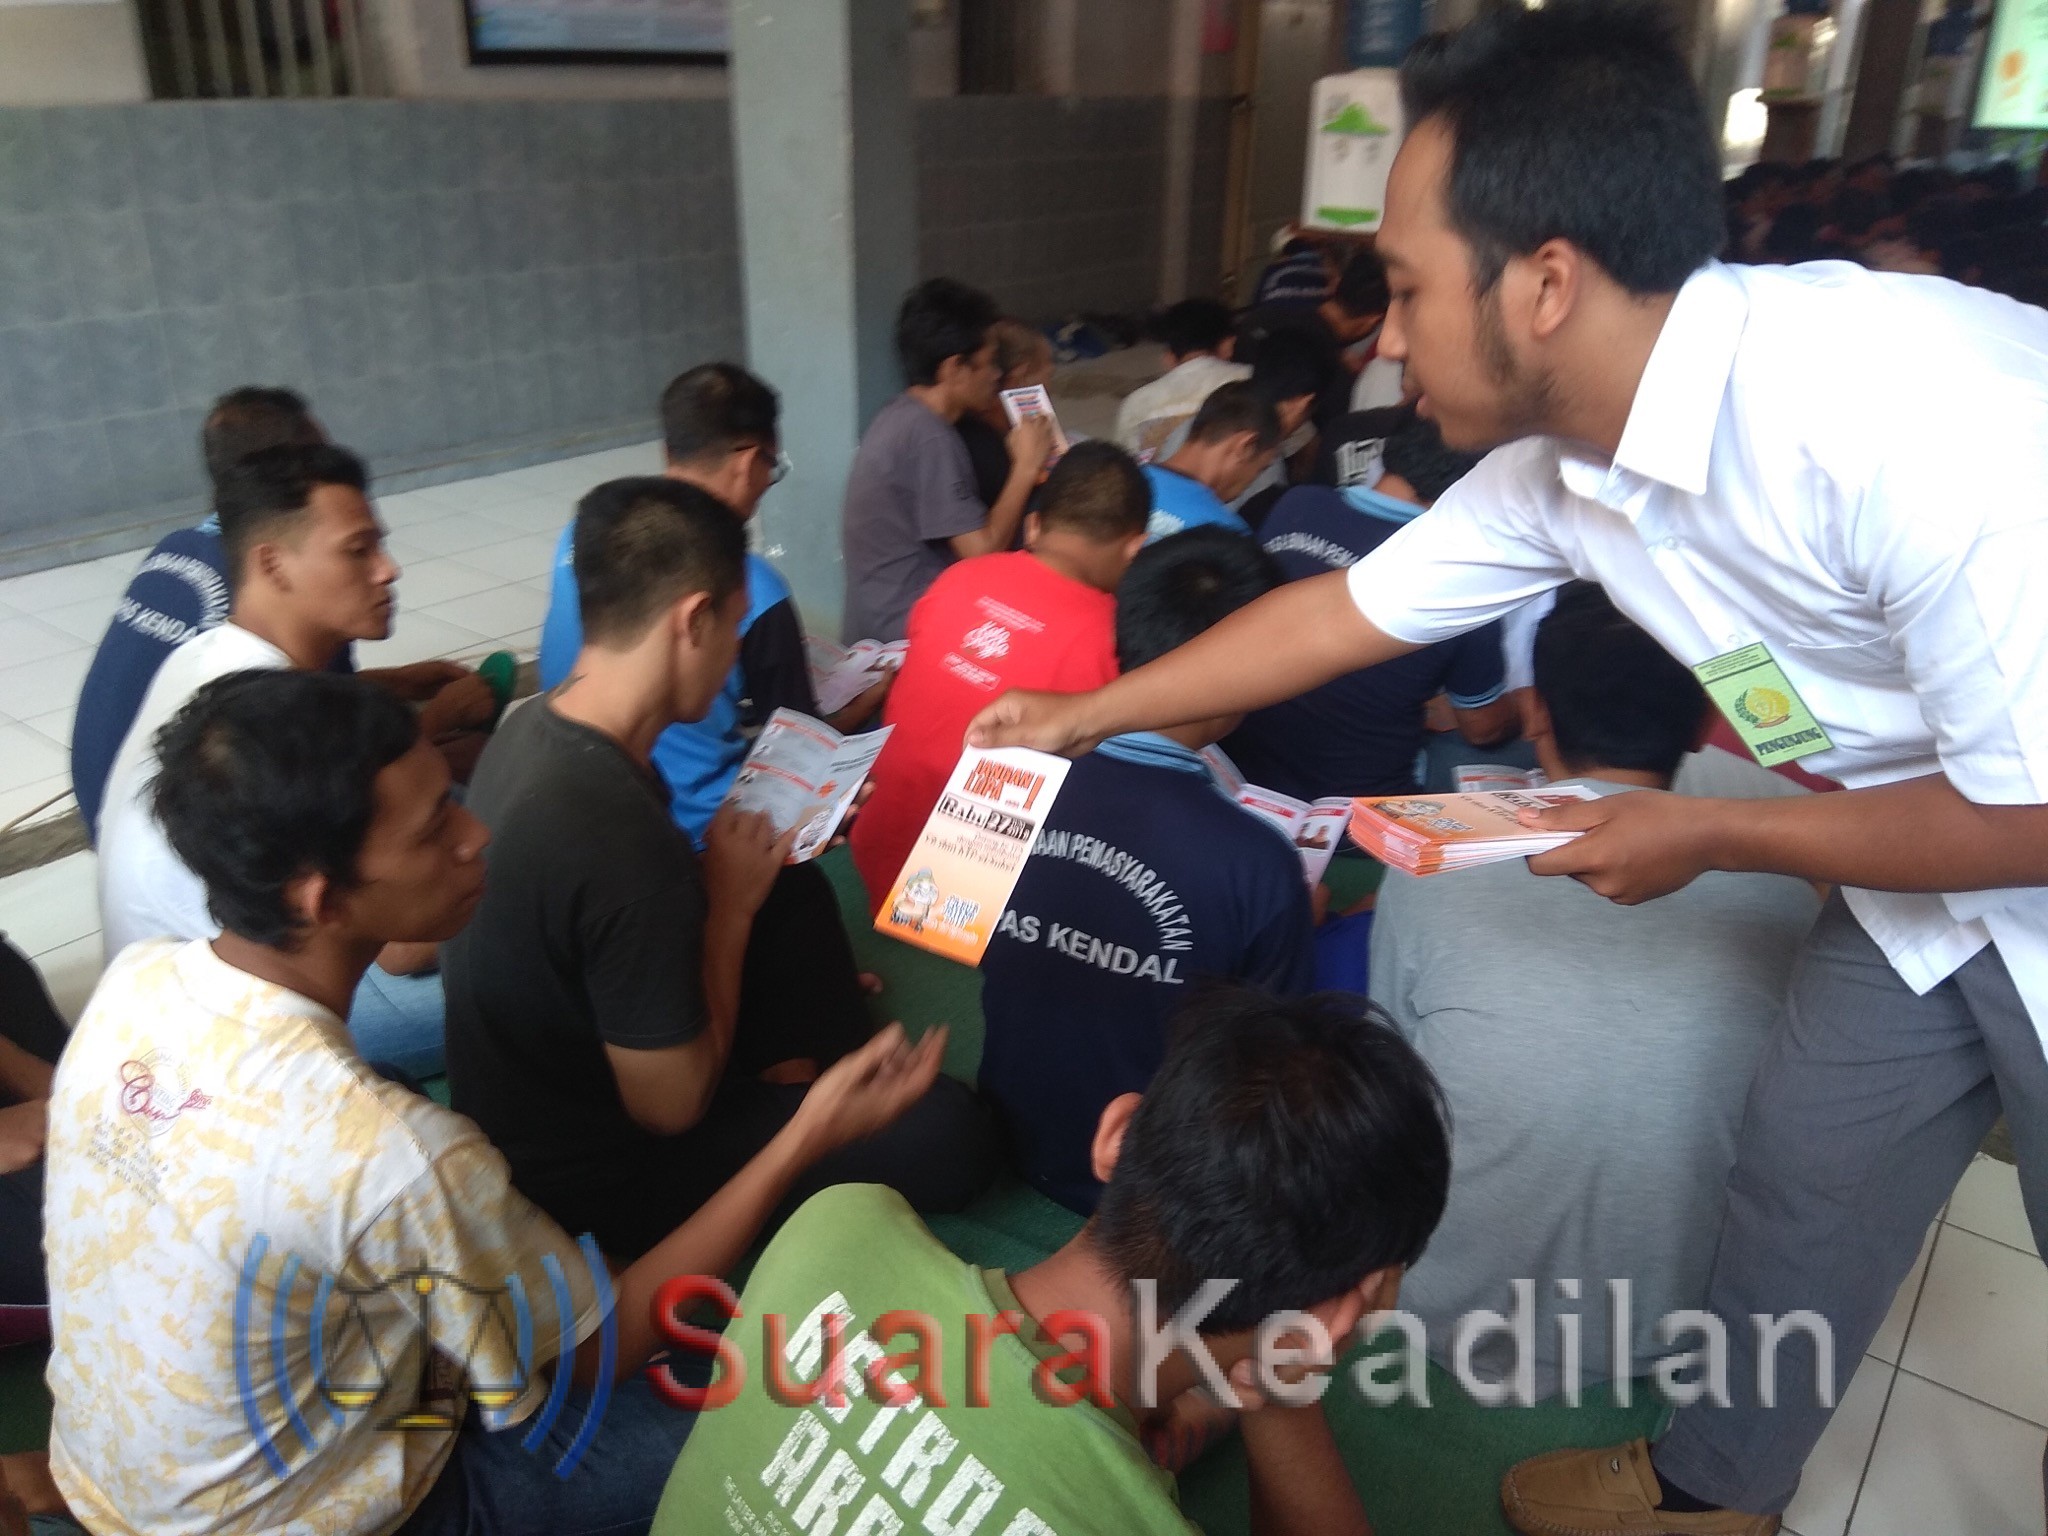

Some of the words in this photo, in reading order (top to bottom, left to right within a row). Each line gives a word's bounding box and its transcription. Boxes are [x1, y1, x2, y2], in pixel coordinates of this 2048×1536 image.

[1031, 829, 1070, 857] AAN
[1067, 833, 1194, 951] PEMASYARAKATAN
[998, 909, 1041, 943] AS
[1046, 922, 1185, 985] KENDAL
